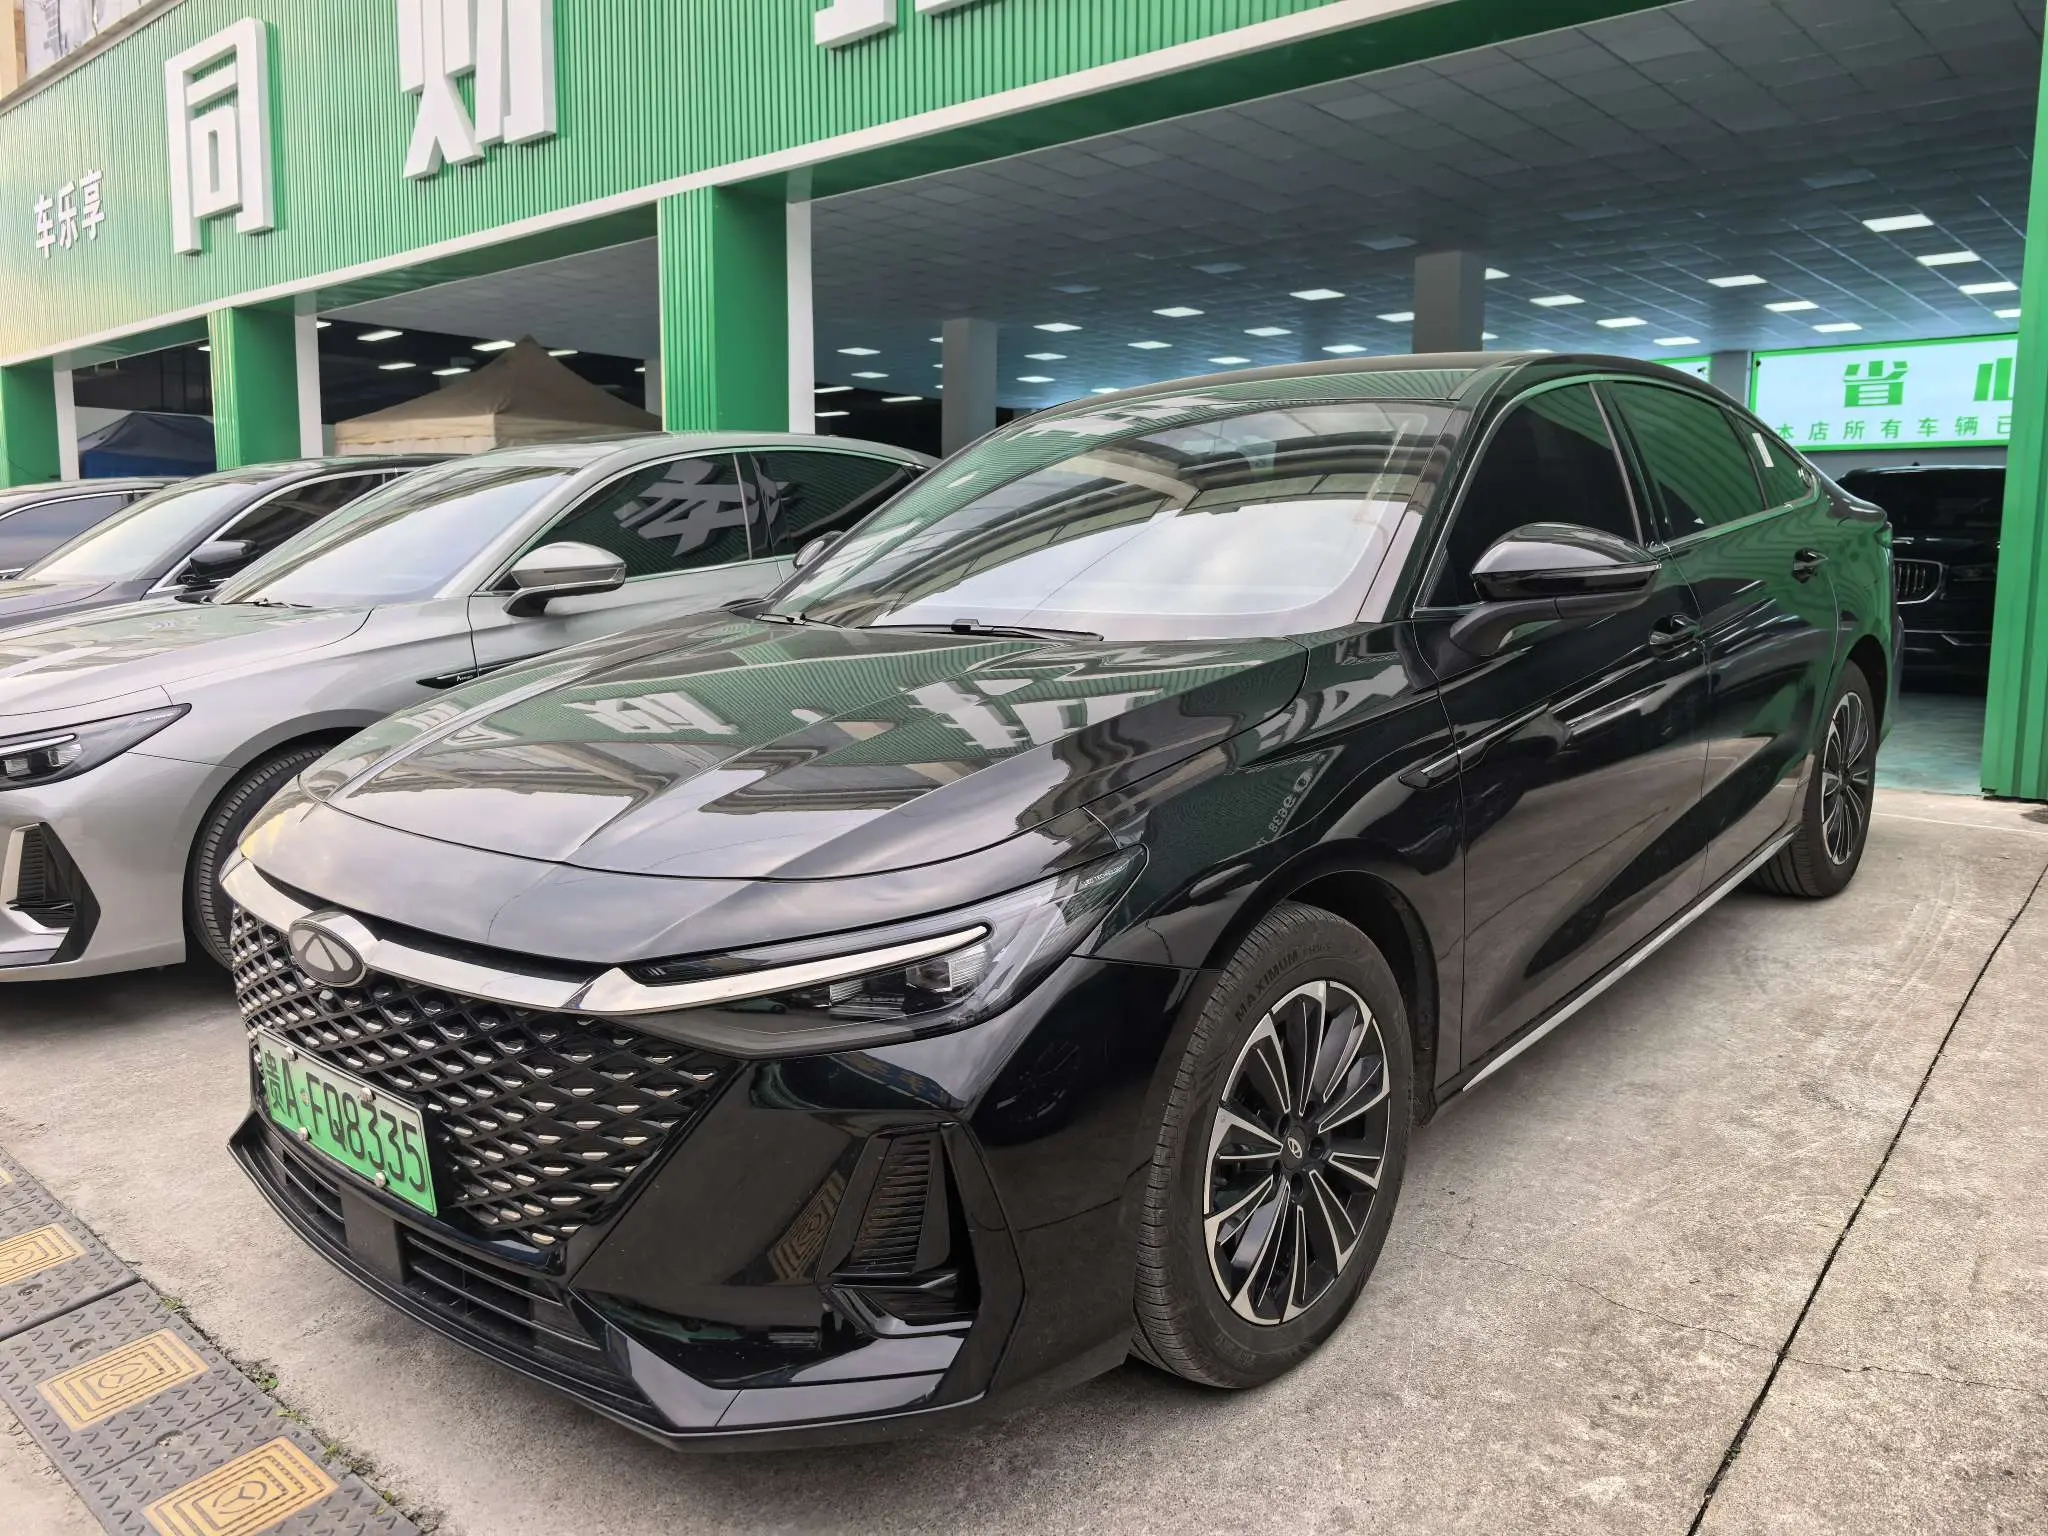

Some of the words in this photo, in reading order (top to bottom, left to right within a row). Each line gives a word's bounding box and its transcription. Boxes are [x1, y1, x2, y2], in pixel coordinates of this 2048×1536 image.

[34, 169, 106, 259] 车乐享
[1234, 950, 1300, 1023] MAXIMUM
